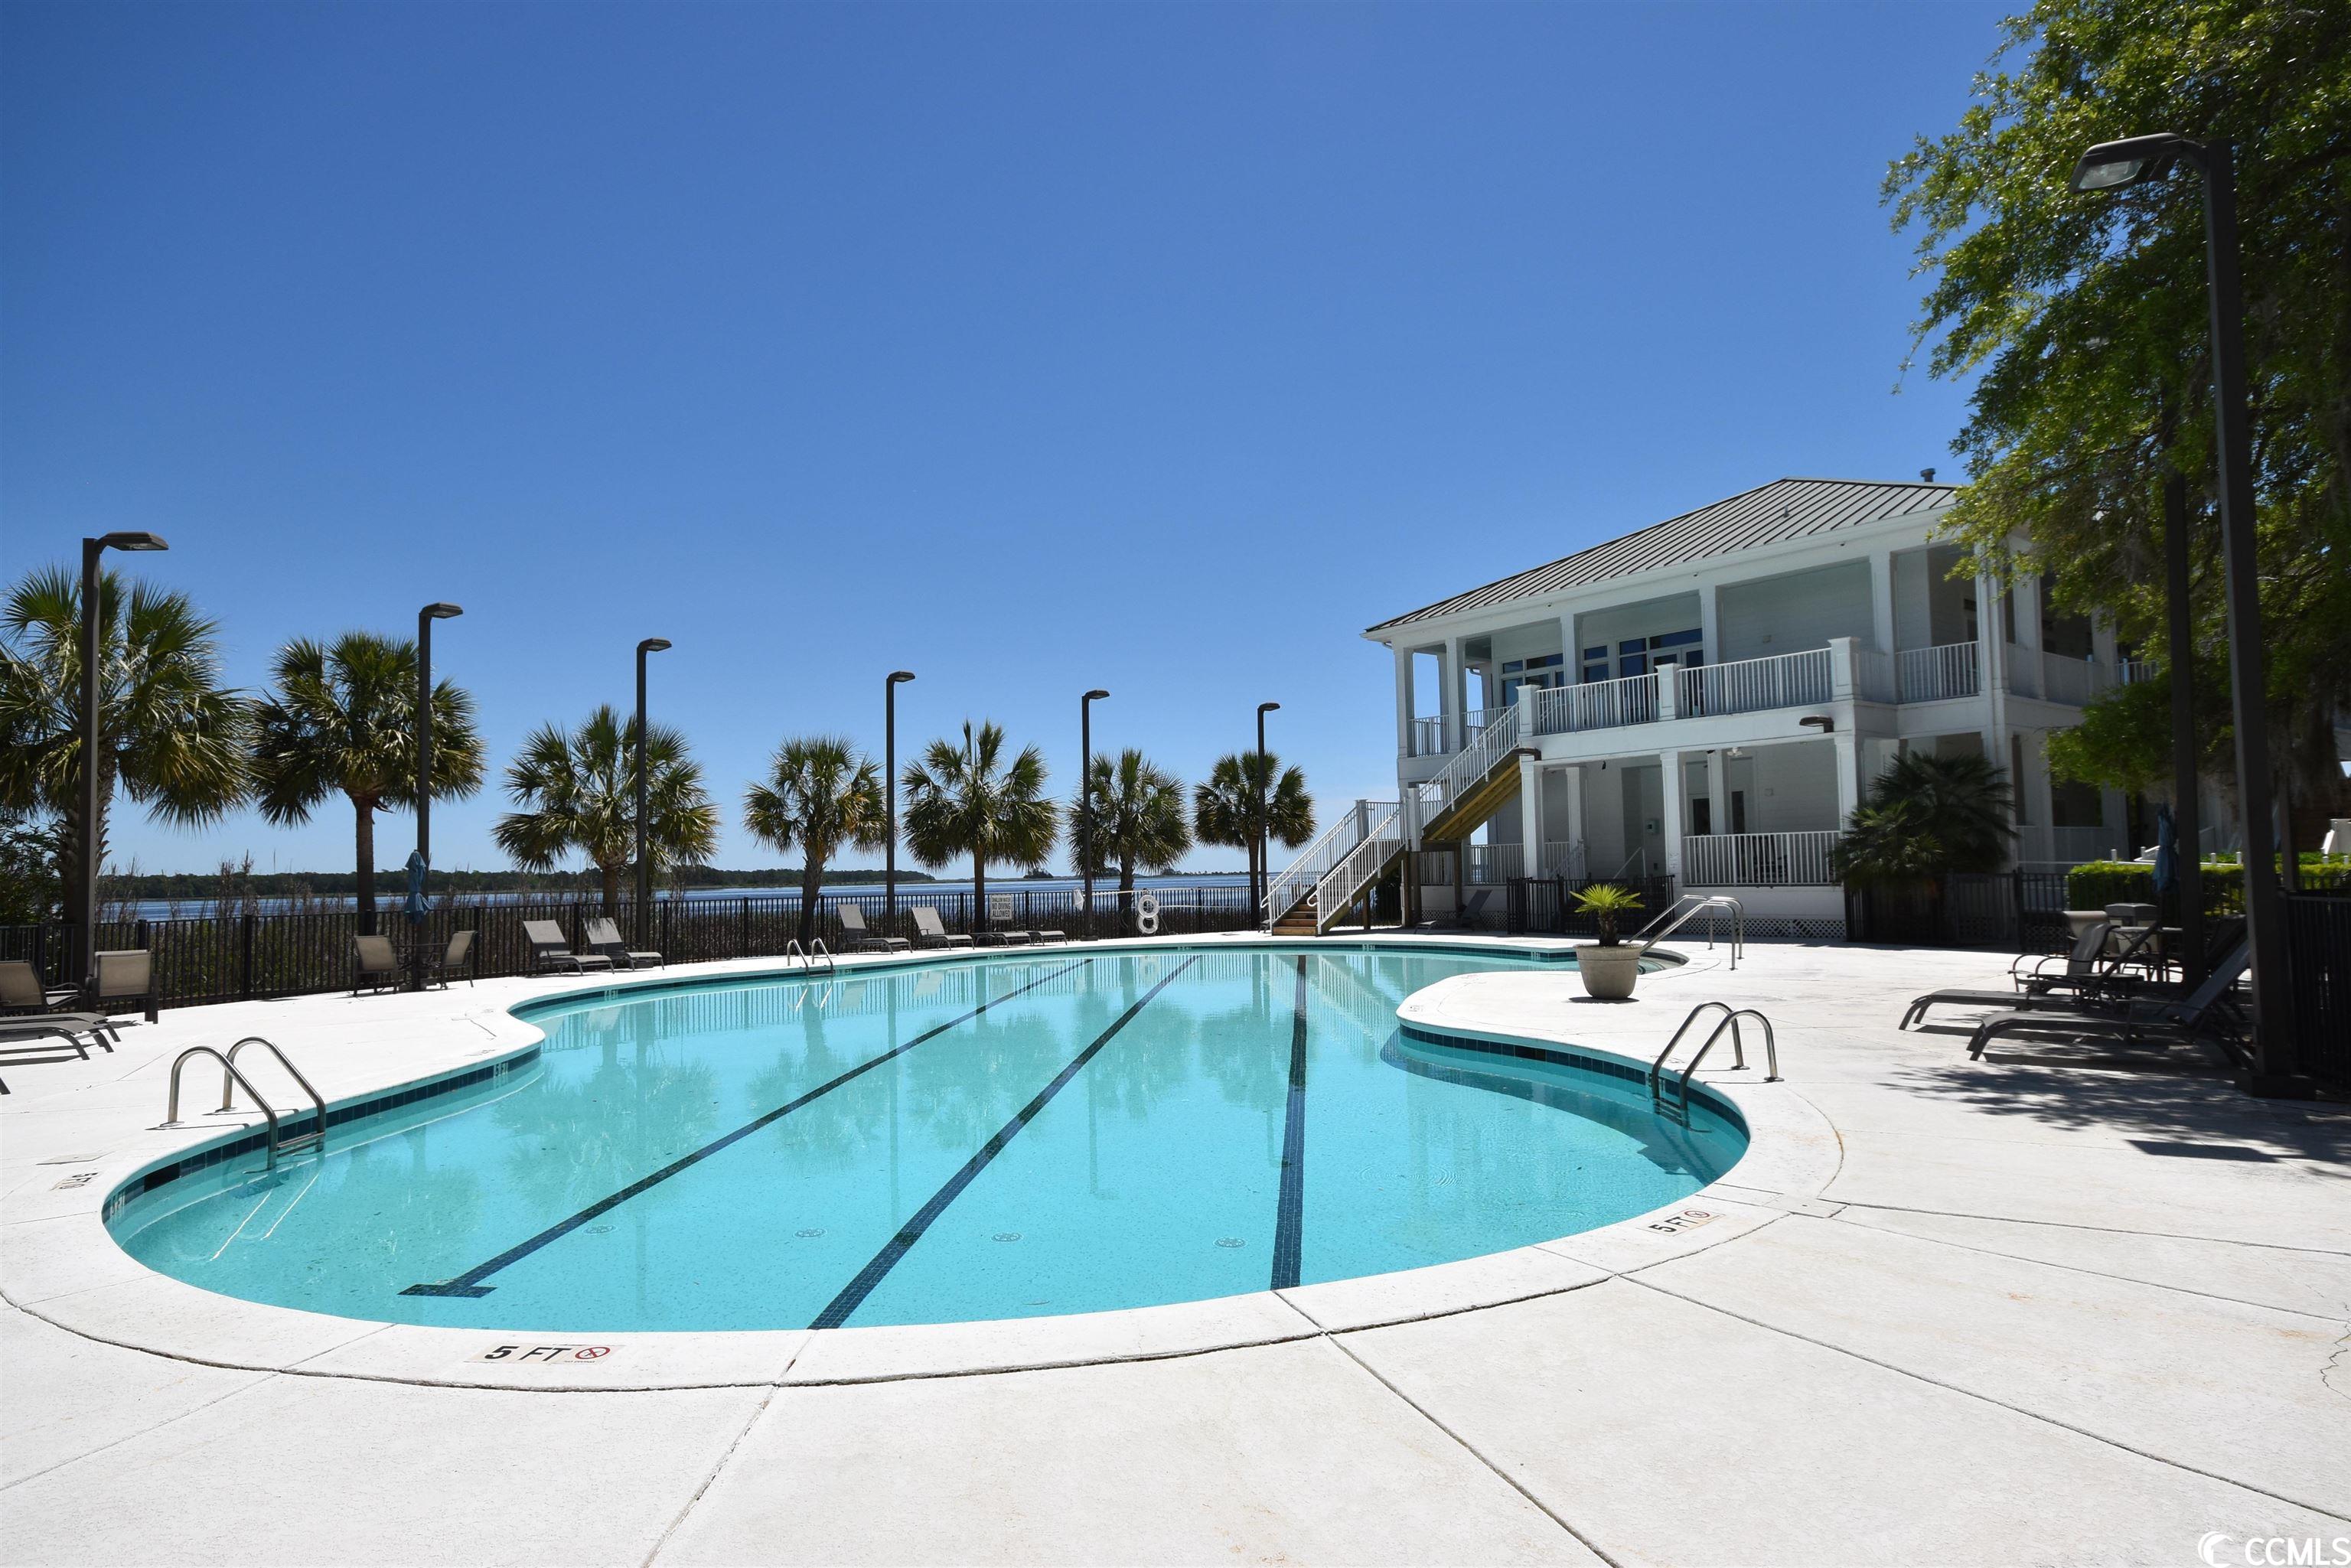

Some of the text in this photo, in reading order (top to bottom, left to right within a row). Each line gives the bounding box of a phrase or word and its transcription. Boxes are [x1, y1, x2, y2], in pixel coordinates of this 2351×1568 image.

[1664, 1217, 1698, 1227] FT
[484, 1345, 572, 1361] 5 FT
